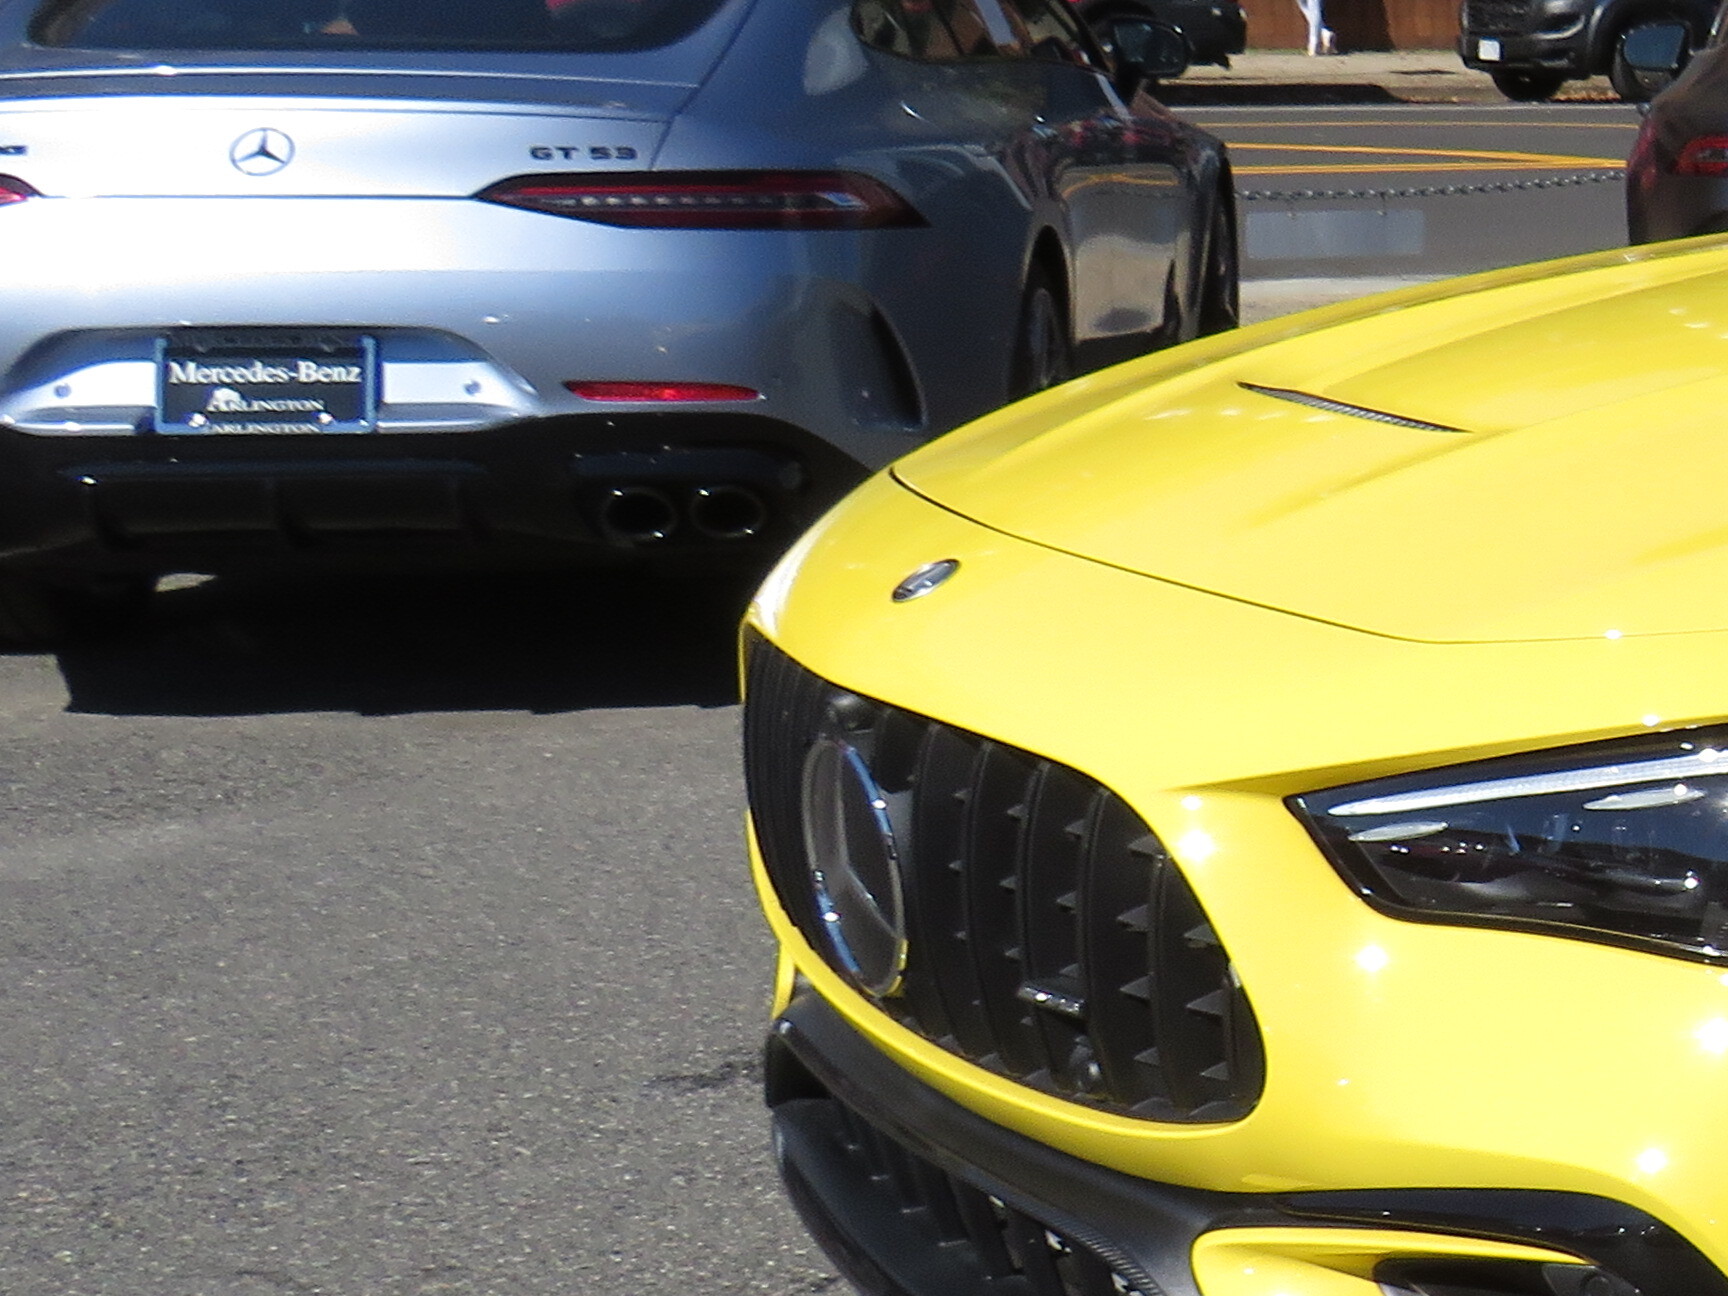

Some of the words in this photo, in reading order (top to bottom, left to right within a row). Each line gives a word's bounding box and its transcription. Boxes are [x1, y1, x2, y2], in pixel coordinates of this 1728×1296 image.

[529, 145, 579, 161] GT
[588, 145, 639, 161] 53
[169, 359, 363, 384] Mercedes-Benz
